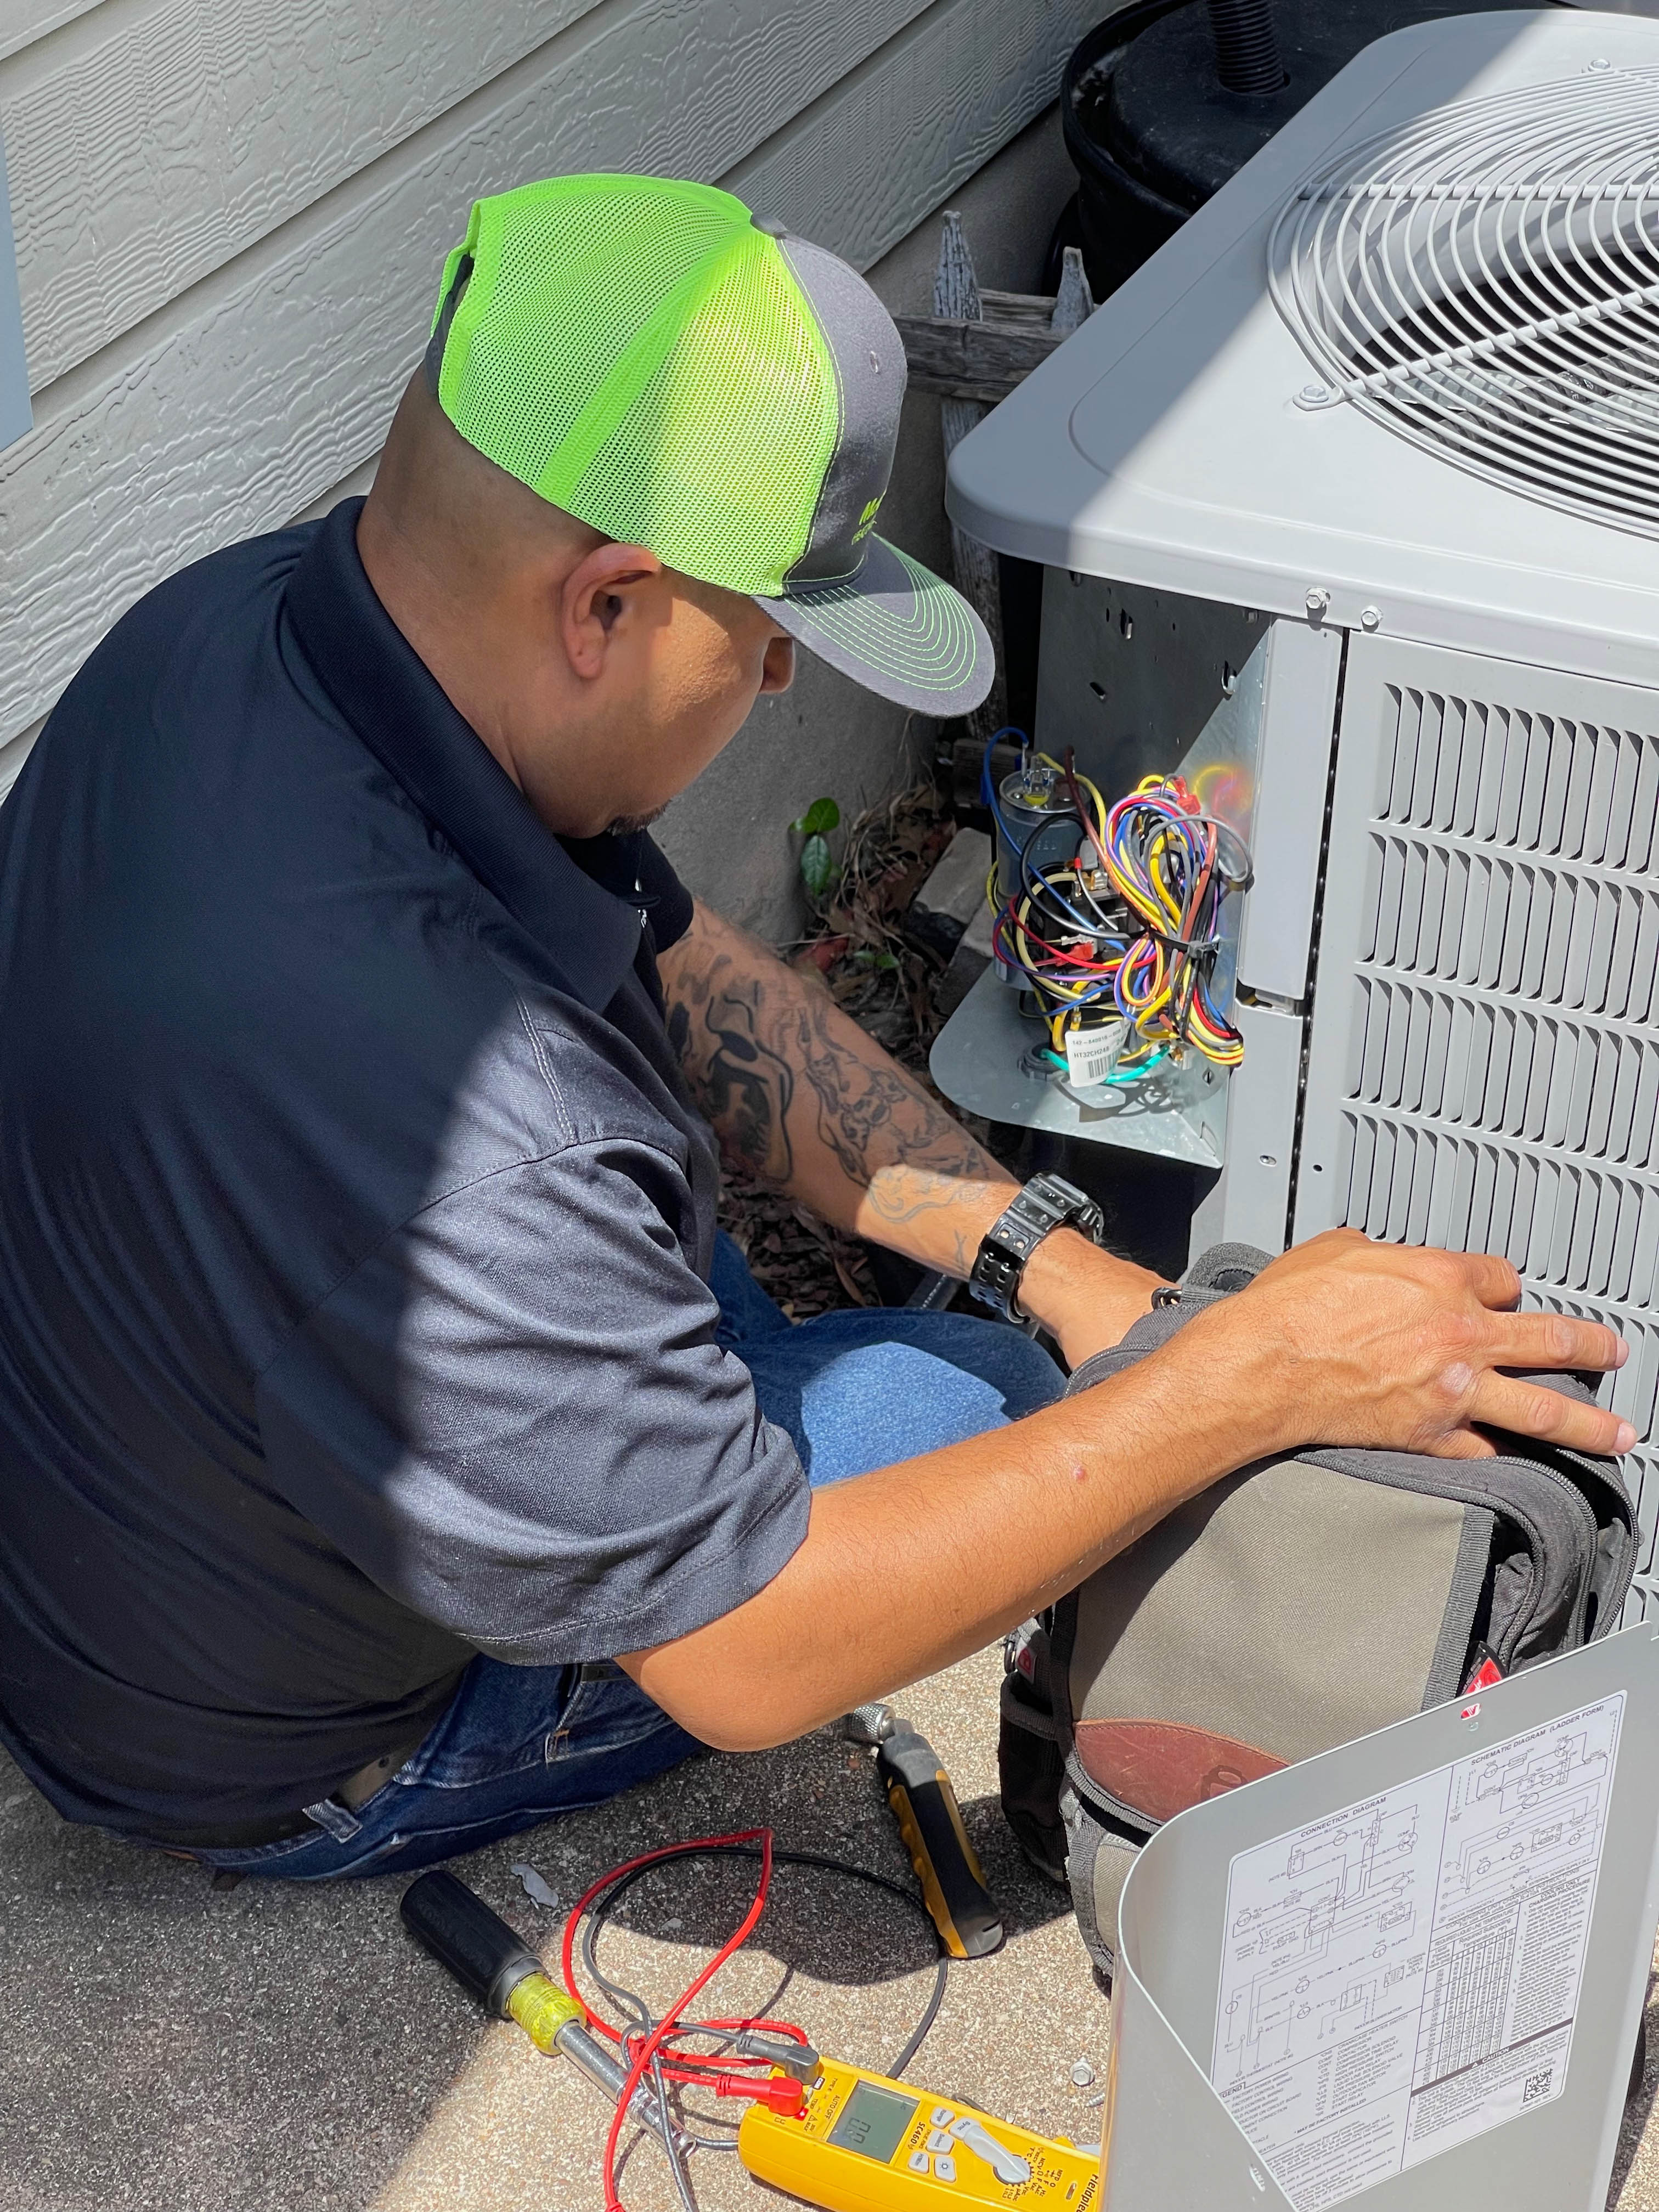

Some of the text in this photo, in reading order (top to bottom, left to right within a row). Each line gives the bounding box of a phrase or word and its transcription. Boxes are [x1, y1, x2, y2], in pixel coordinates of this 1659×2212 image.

[1471, 1704, 1604, 1765] SCHEMATIC DIAGRAM (LADDER FORM)
[1301, 1797, 1386, 1838] CONNECTION DIAGRAM
[1482, 2047, 1509, 2063] CAUTION
[1221, 2085, 1242, 2099] GEND
[825, 2095, 840, 2119] AUTO OFF
[911, 2122, 925, 2144] SC460
